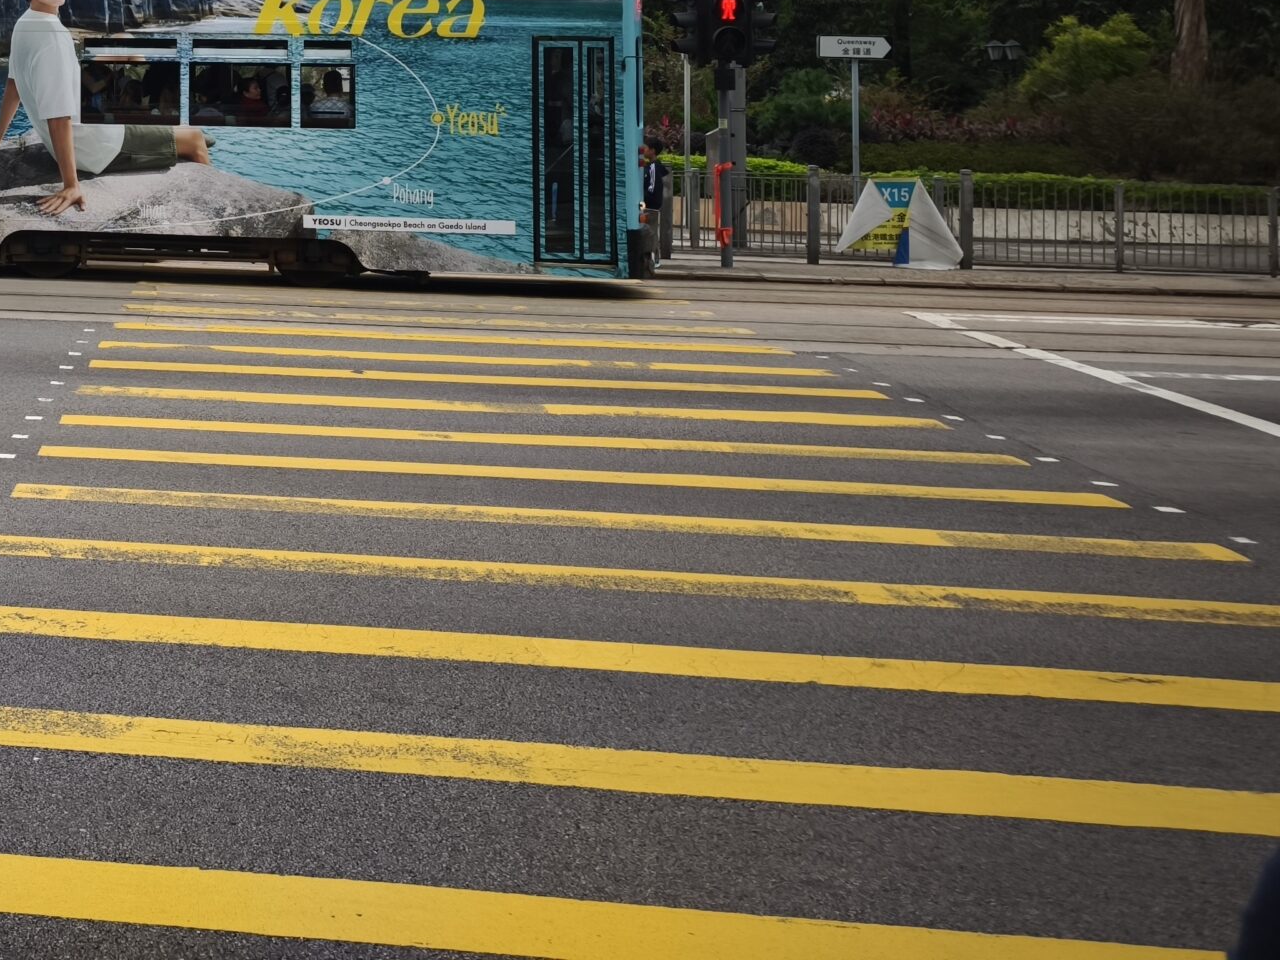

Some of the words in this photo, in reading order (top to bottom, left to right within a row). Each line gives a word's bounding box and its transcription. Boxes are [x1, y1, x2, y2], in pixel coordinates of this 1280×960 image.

[446, 103, 499, 136] Yeosu
[393, 183, 434, 209] Pohang
[882, 188, 909, 202] X15
[312, 218, 342, 226] YEOSU
[349, 219, 401, 229] Cheongseokpo
[403, 221, 425, 229] Beach
[438, 222, 463, 230] Gaedo
[465, 222, 487, 231] Island
